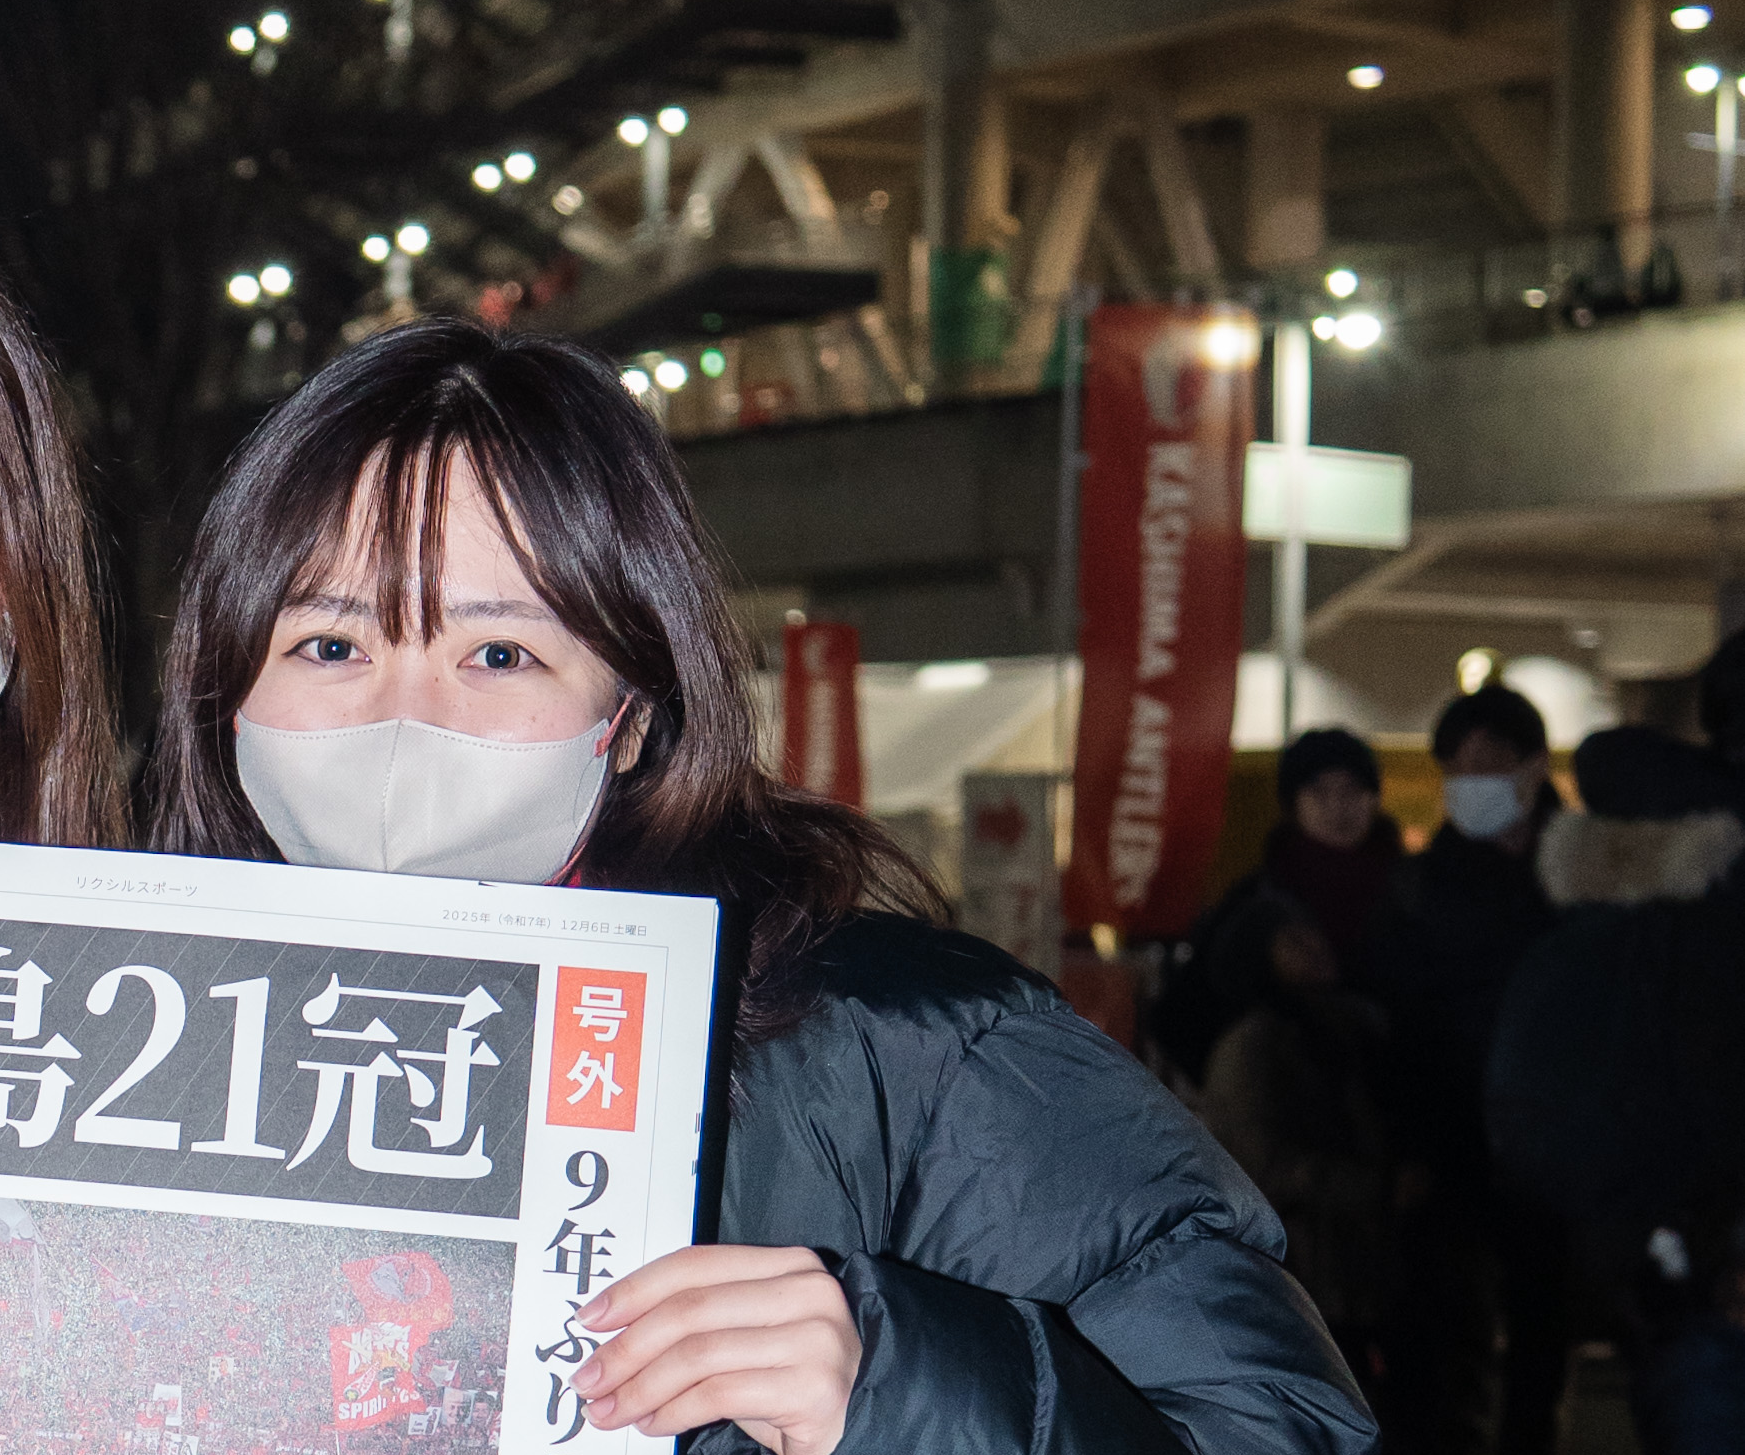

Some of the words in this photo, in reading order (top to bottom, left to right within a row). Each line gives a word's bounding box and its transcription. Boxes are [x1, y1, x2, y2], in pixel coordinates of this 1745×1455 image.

[76, 875, 198, 897] リクシルスポーツ
[566, 985, 628, 1109] 号外
